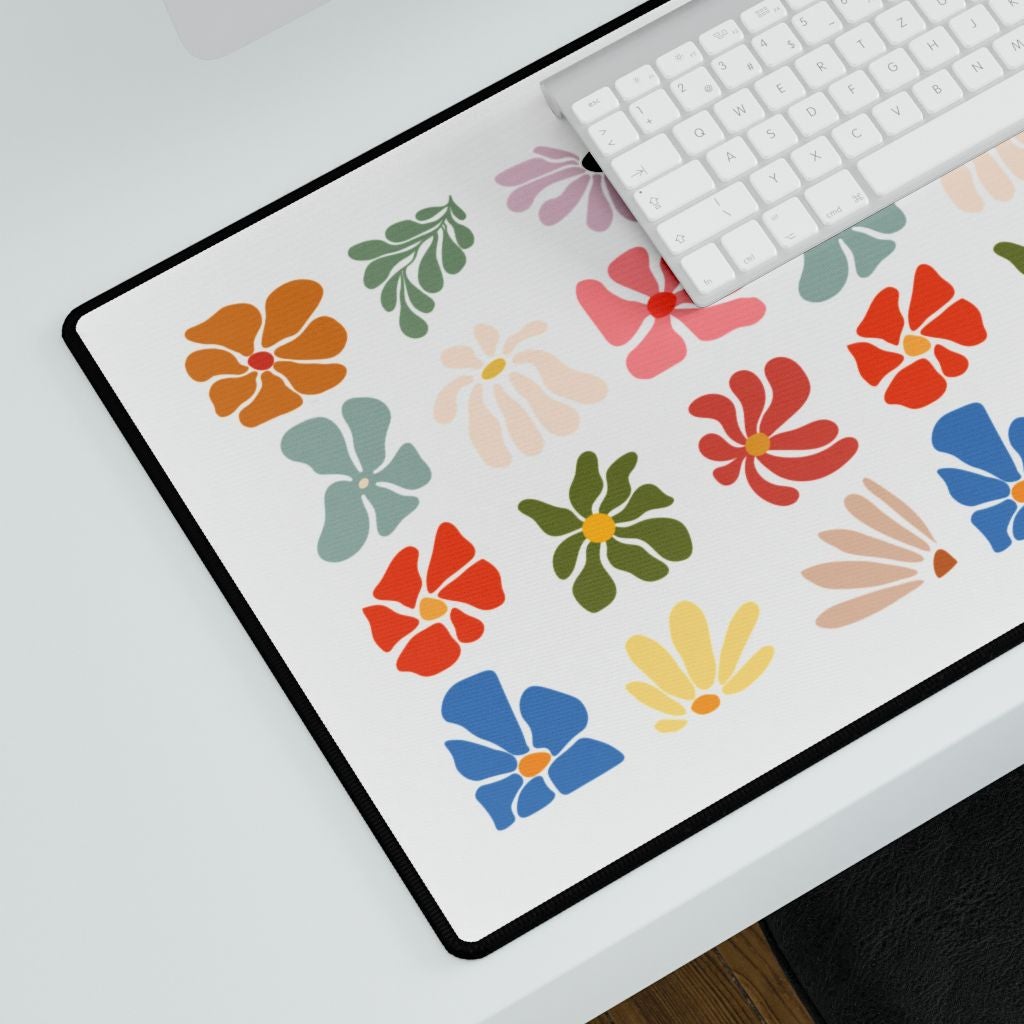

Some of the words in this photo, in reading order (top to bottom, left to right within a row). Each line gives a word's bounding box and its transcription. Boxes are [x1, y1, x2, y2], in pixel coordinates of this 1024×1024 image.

[799, 16, 808, 27] 5
[897, 17, 908, 29] Z
[970, 18, 977, 29] J
[760, 38, 769, 48] 4
[856, 38, 866, 49] T
[926, 39, 940, 52] H
[1011, 39, 1024, 51] M
[718, 61, 728, 71] 3
[816, 61, 828, 72] R
[887, 61, 899, 73] G
[971, 61, 984, 73] N
[677, 82, 687, 93] 2
[776, 82, 786, 94] E
[847, 83, 856, 95] F
[931, 84, 943, 95] B
[732, 104, 747, 117] W
[806, 106, 817, 118] D
[890, 105, 901, 117] V
[694, 127, 707, 138] Q
[766, 128, 777, 139] S
[851, 128, 863, 139] C
[726, 151, 737, 163] A
[809, 150, 823, 163] X
[768, 172, 779, 184] Y
